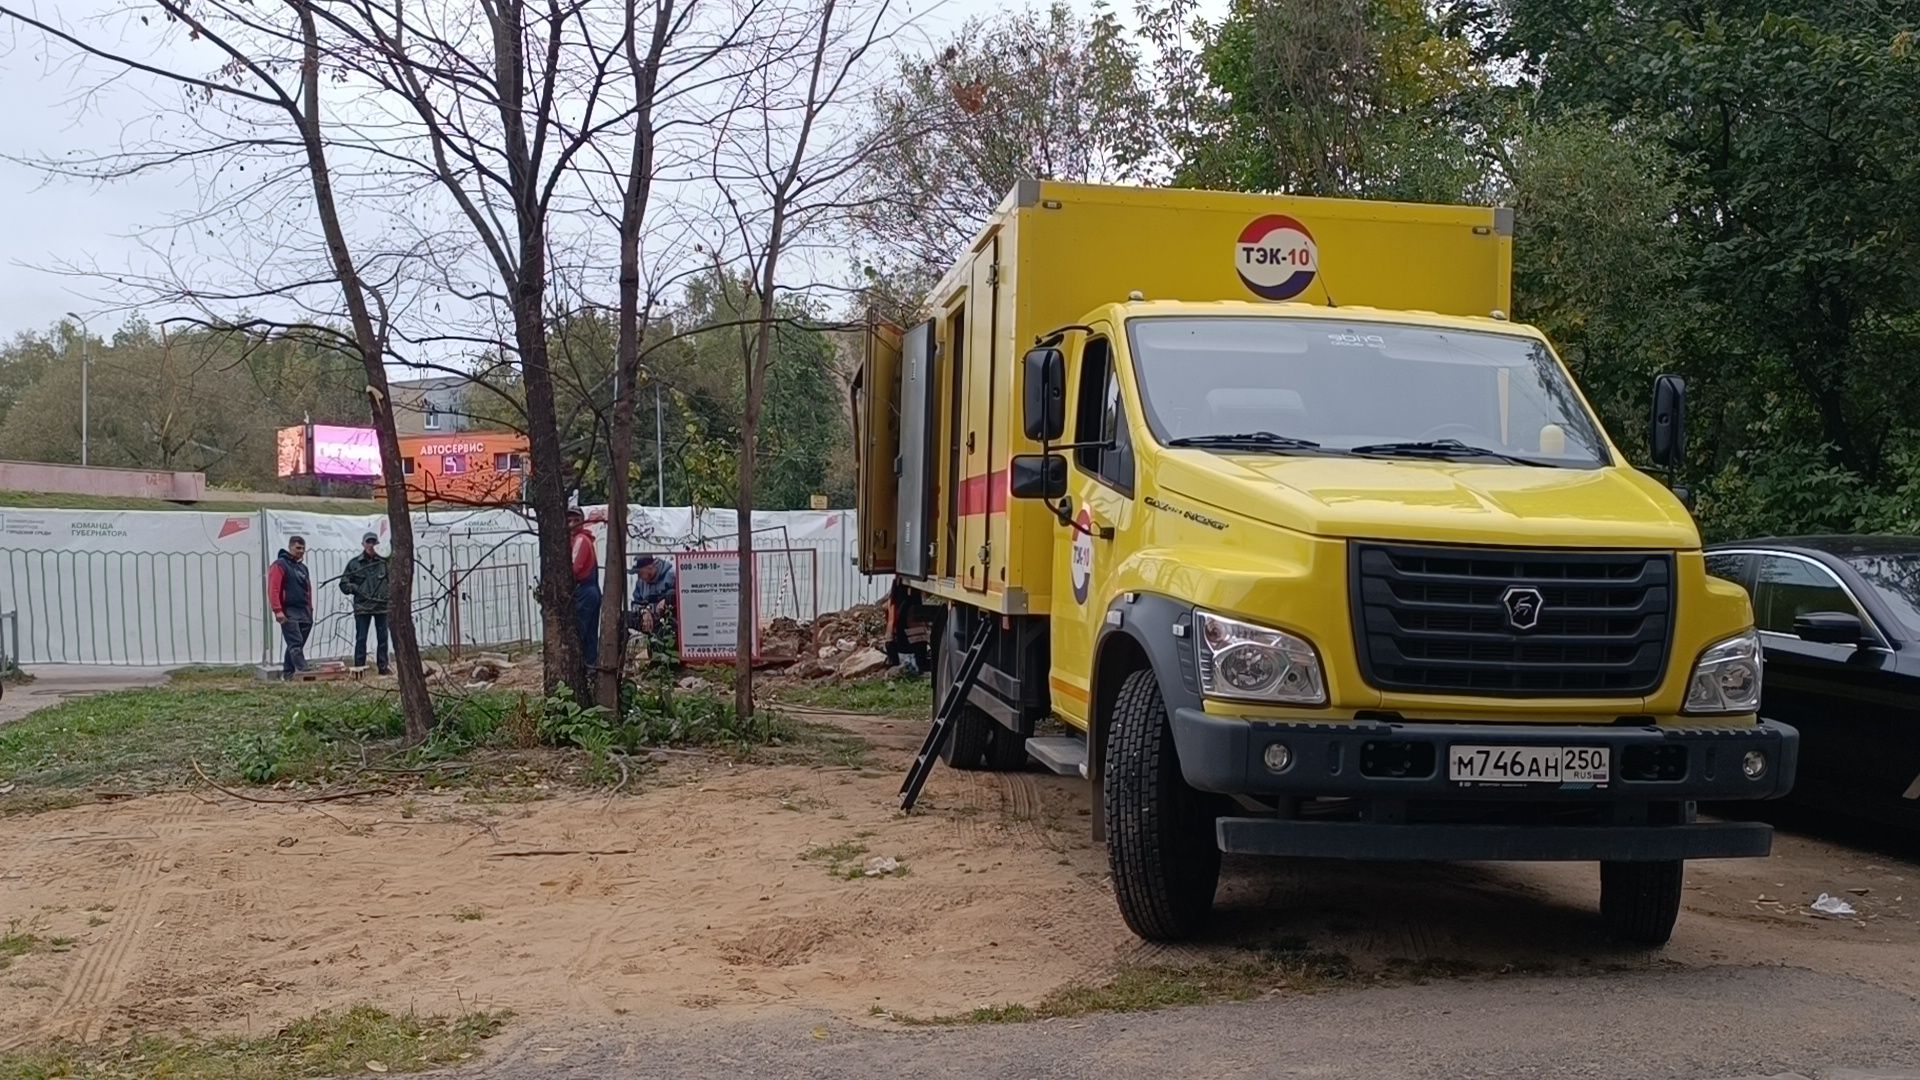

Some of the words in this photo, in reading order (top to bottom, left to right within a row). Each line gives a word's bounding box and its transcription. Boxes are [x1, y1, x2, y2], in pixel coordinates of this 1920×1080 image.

[1242, 247, 1310, 266] ТЭК-10
[420, 442, 484, 455] АВТОСЕРВИС
[71, 529, 127, 537] ГУБЕРНАТОРА
[1457, 750, 1559, 777] М746АН
[1564, 750, 1603, 770] 250
[1573, 771, 1592, 779] RUS
